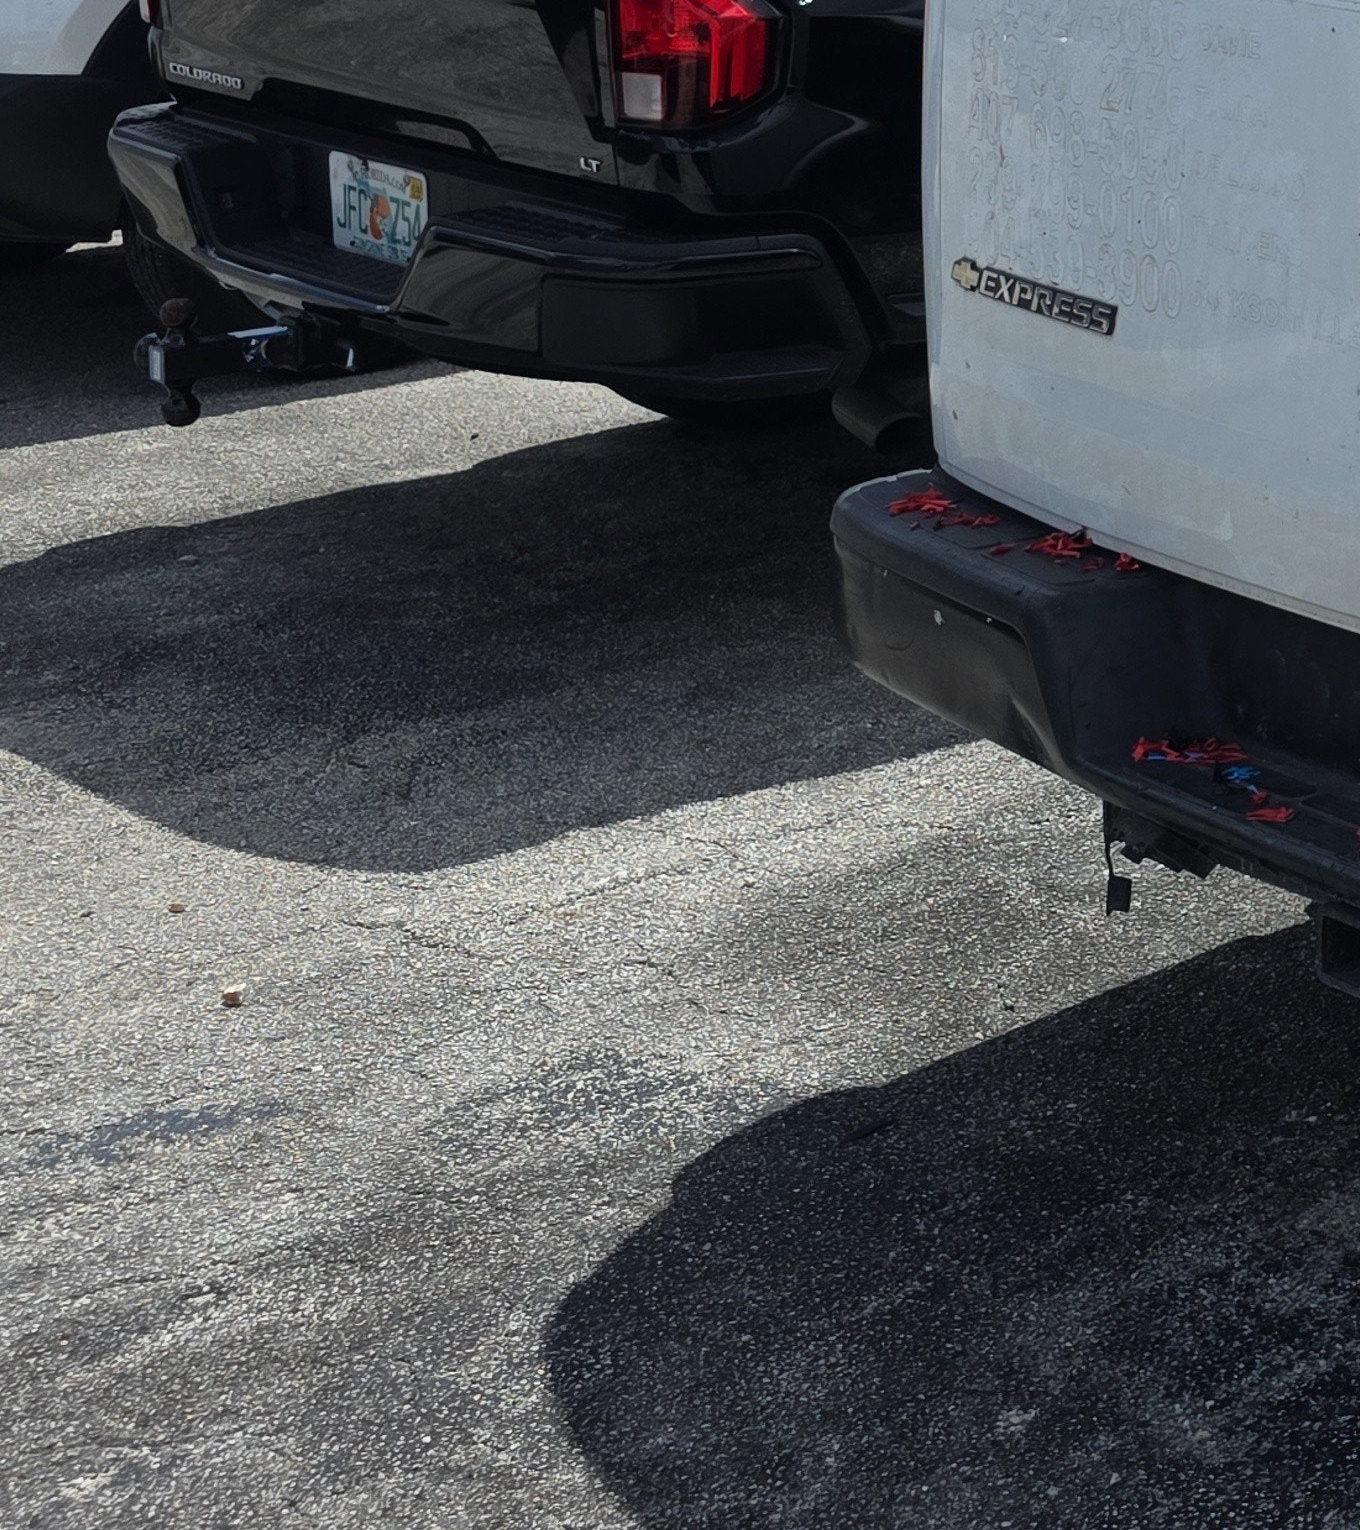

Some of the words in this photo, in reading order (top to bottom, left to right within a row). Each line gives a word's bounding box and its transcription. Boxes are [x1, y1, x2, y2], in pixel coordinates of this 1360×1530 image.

[169, 61, 243, 90] COLORADO
[579, 156, 602, 174] LT
[336, 183, 368, 235] JFC
[980, 270, 1109, 334] EXPRESS
